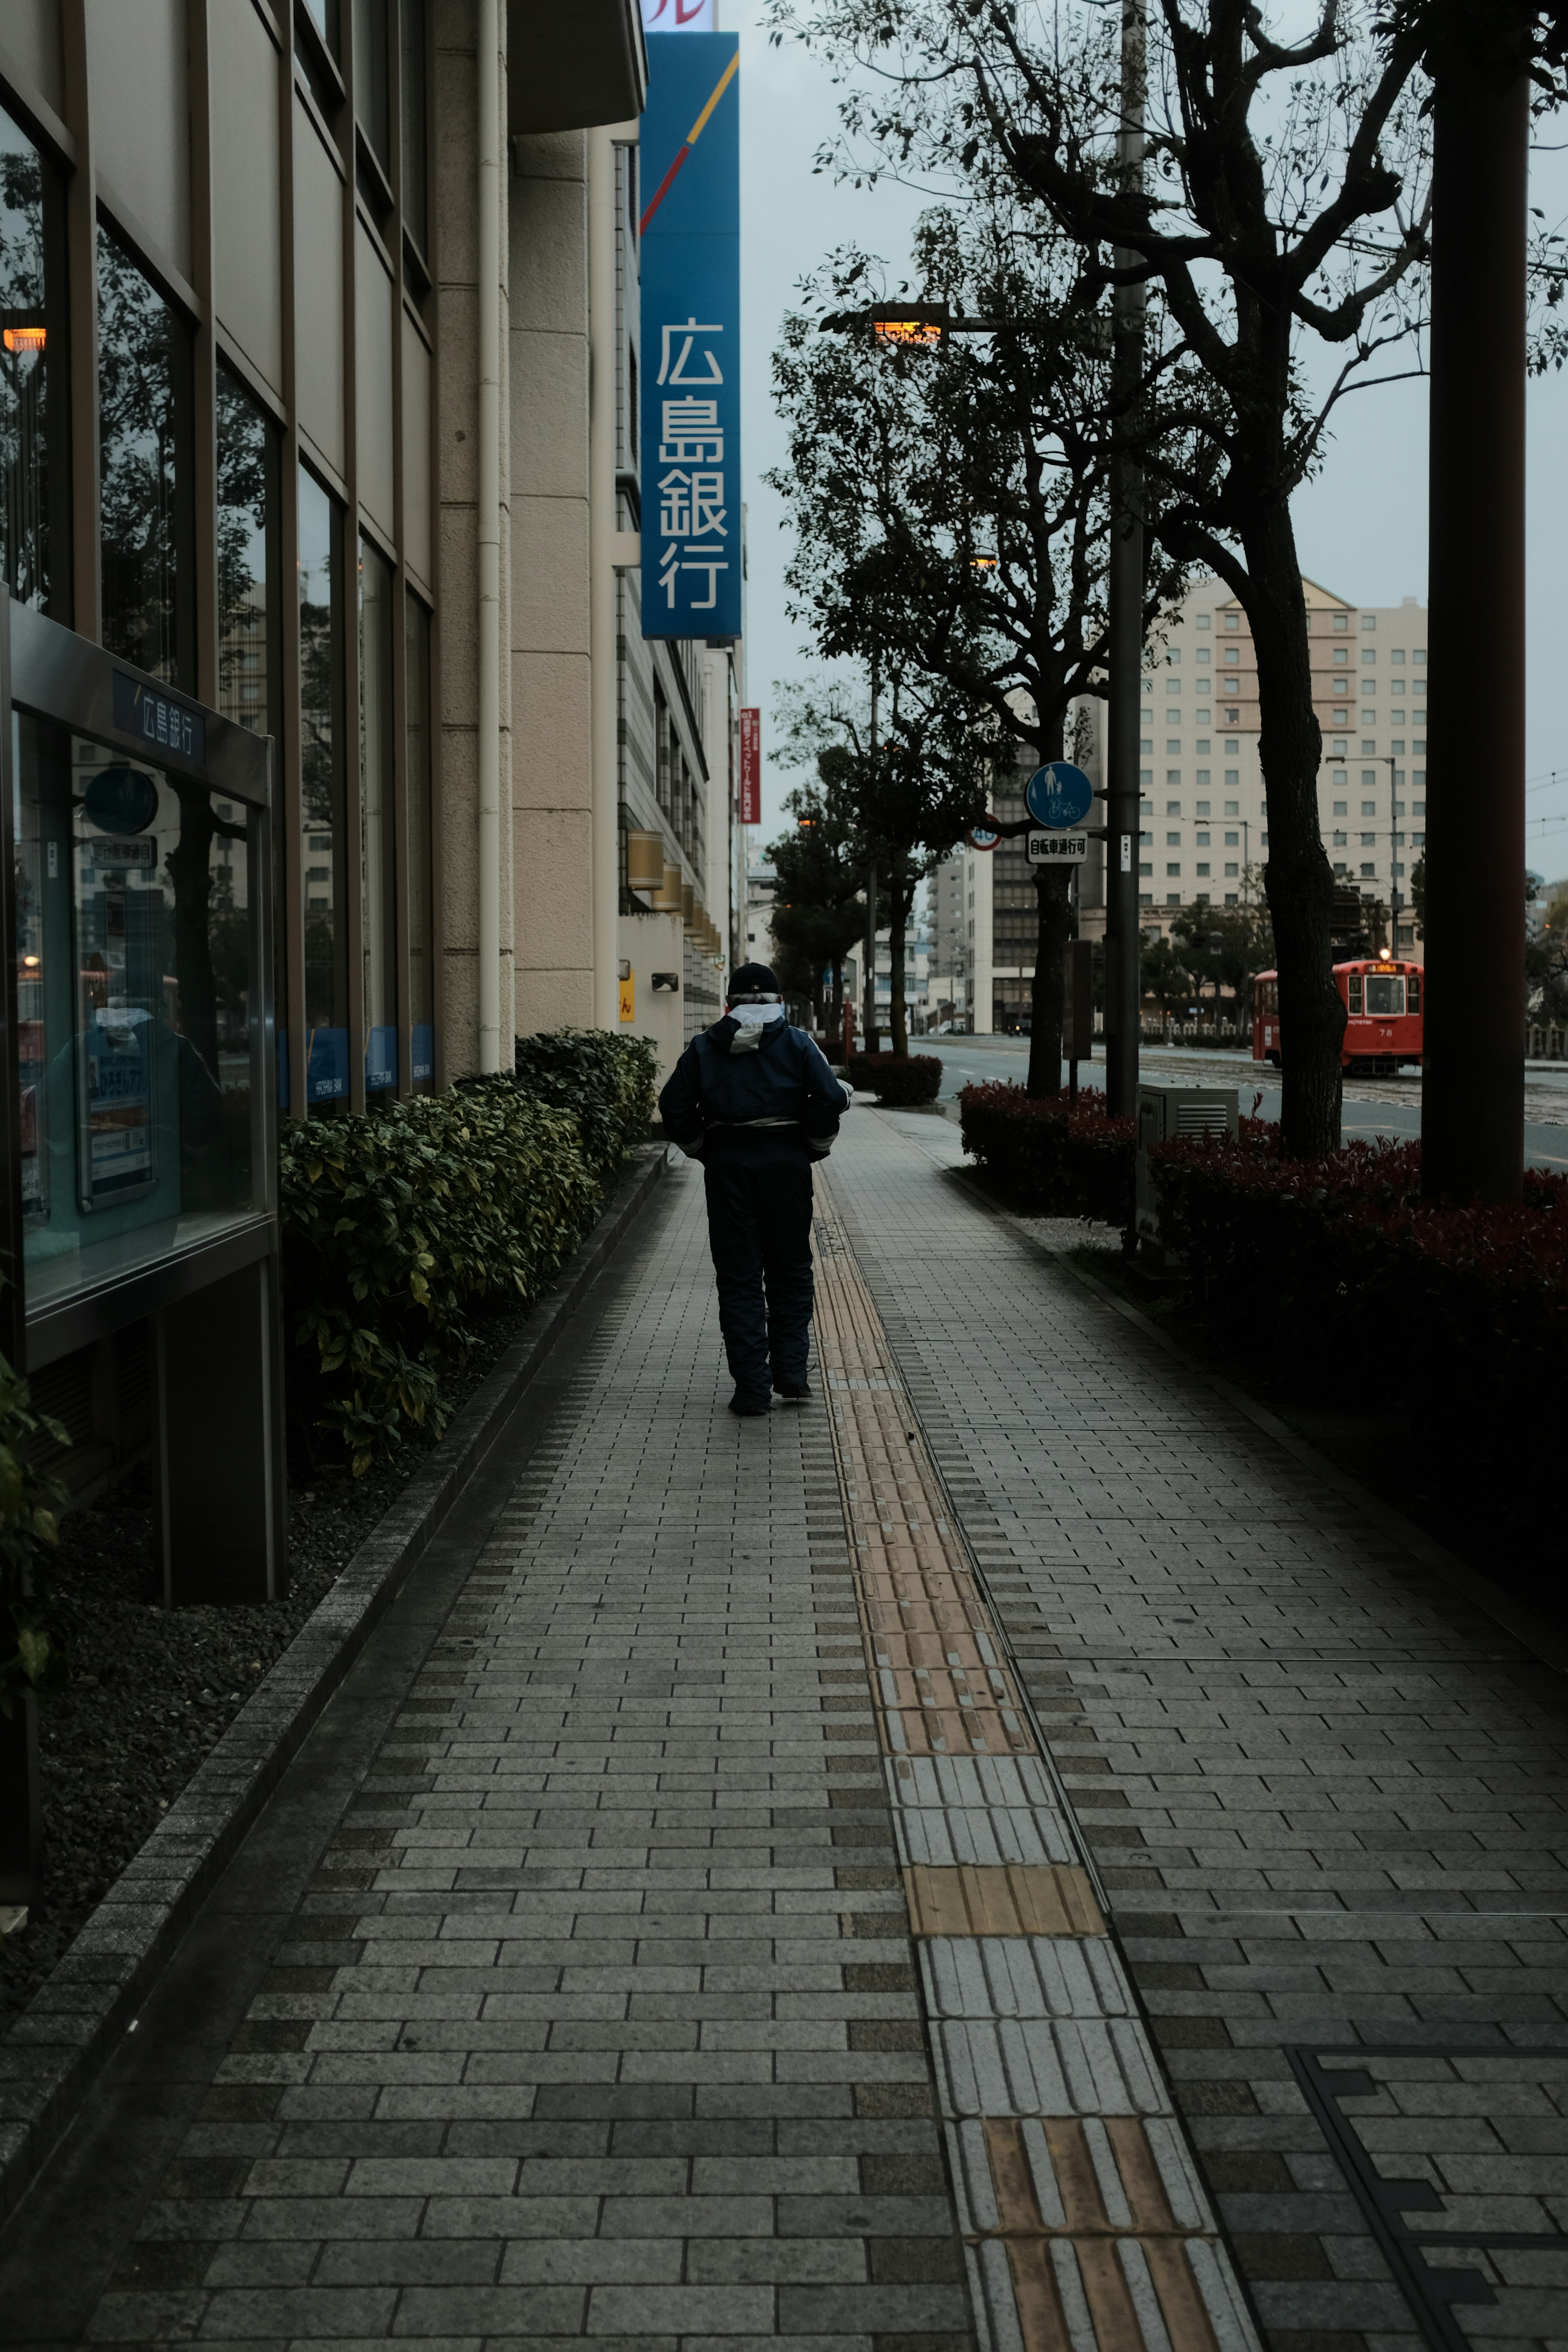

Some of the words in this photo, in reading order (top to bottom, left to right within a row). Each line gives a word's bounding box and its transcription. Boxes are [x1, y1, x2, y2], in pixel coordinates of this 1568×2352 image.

[656, 317, 729, 608] 広島銀行
[144, 694, 192, 755] 広島銀行
[1031, 838, 1086, 855] 自転車通行可
[1379, 1029, 1392, 1037] 78
[315, 1079, 332, 1096] HIROSHIMA
[334, 1078, 342, 1093] BANK
